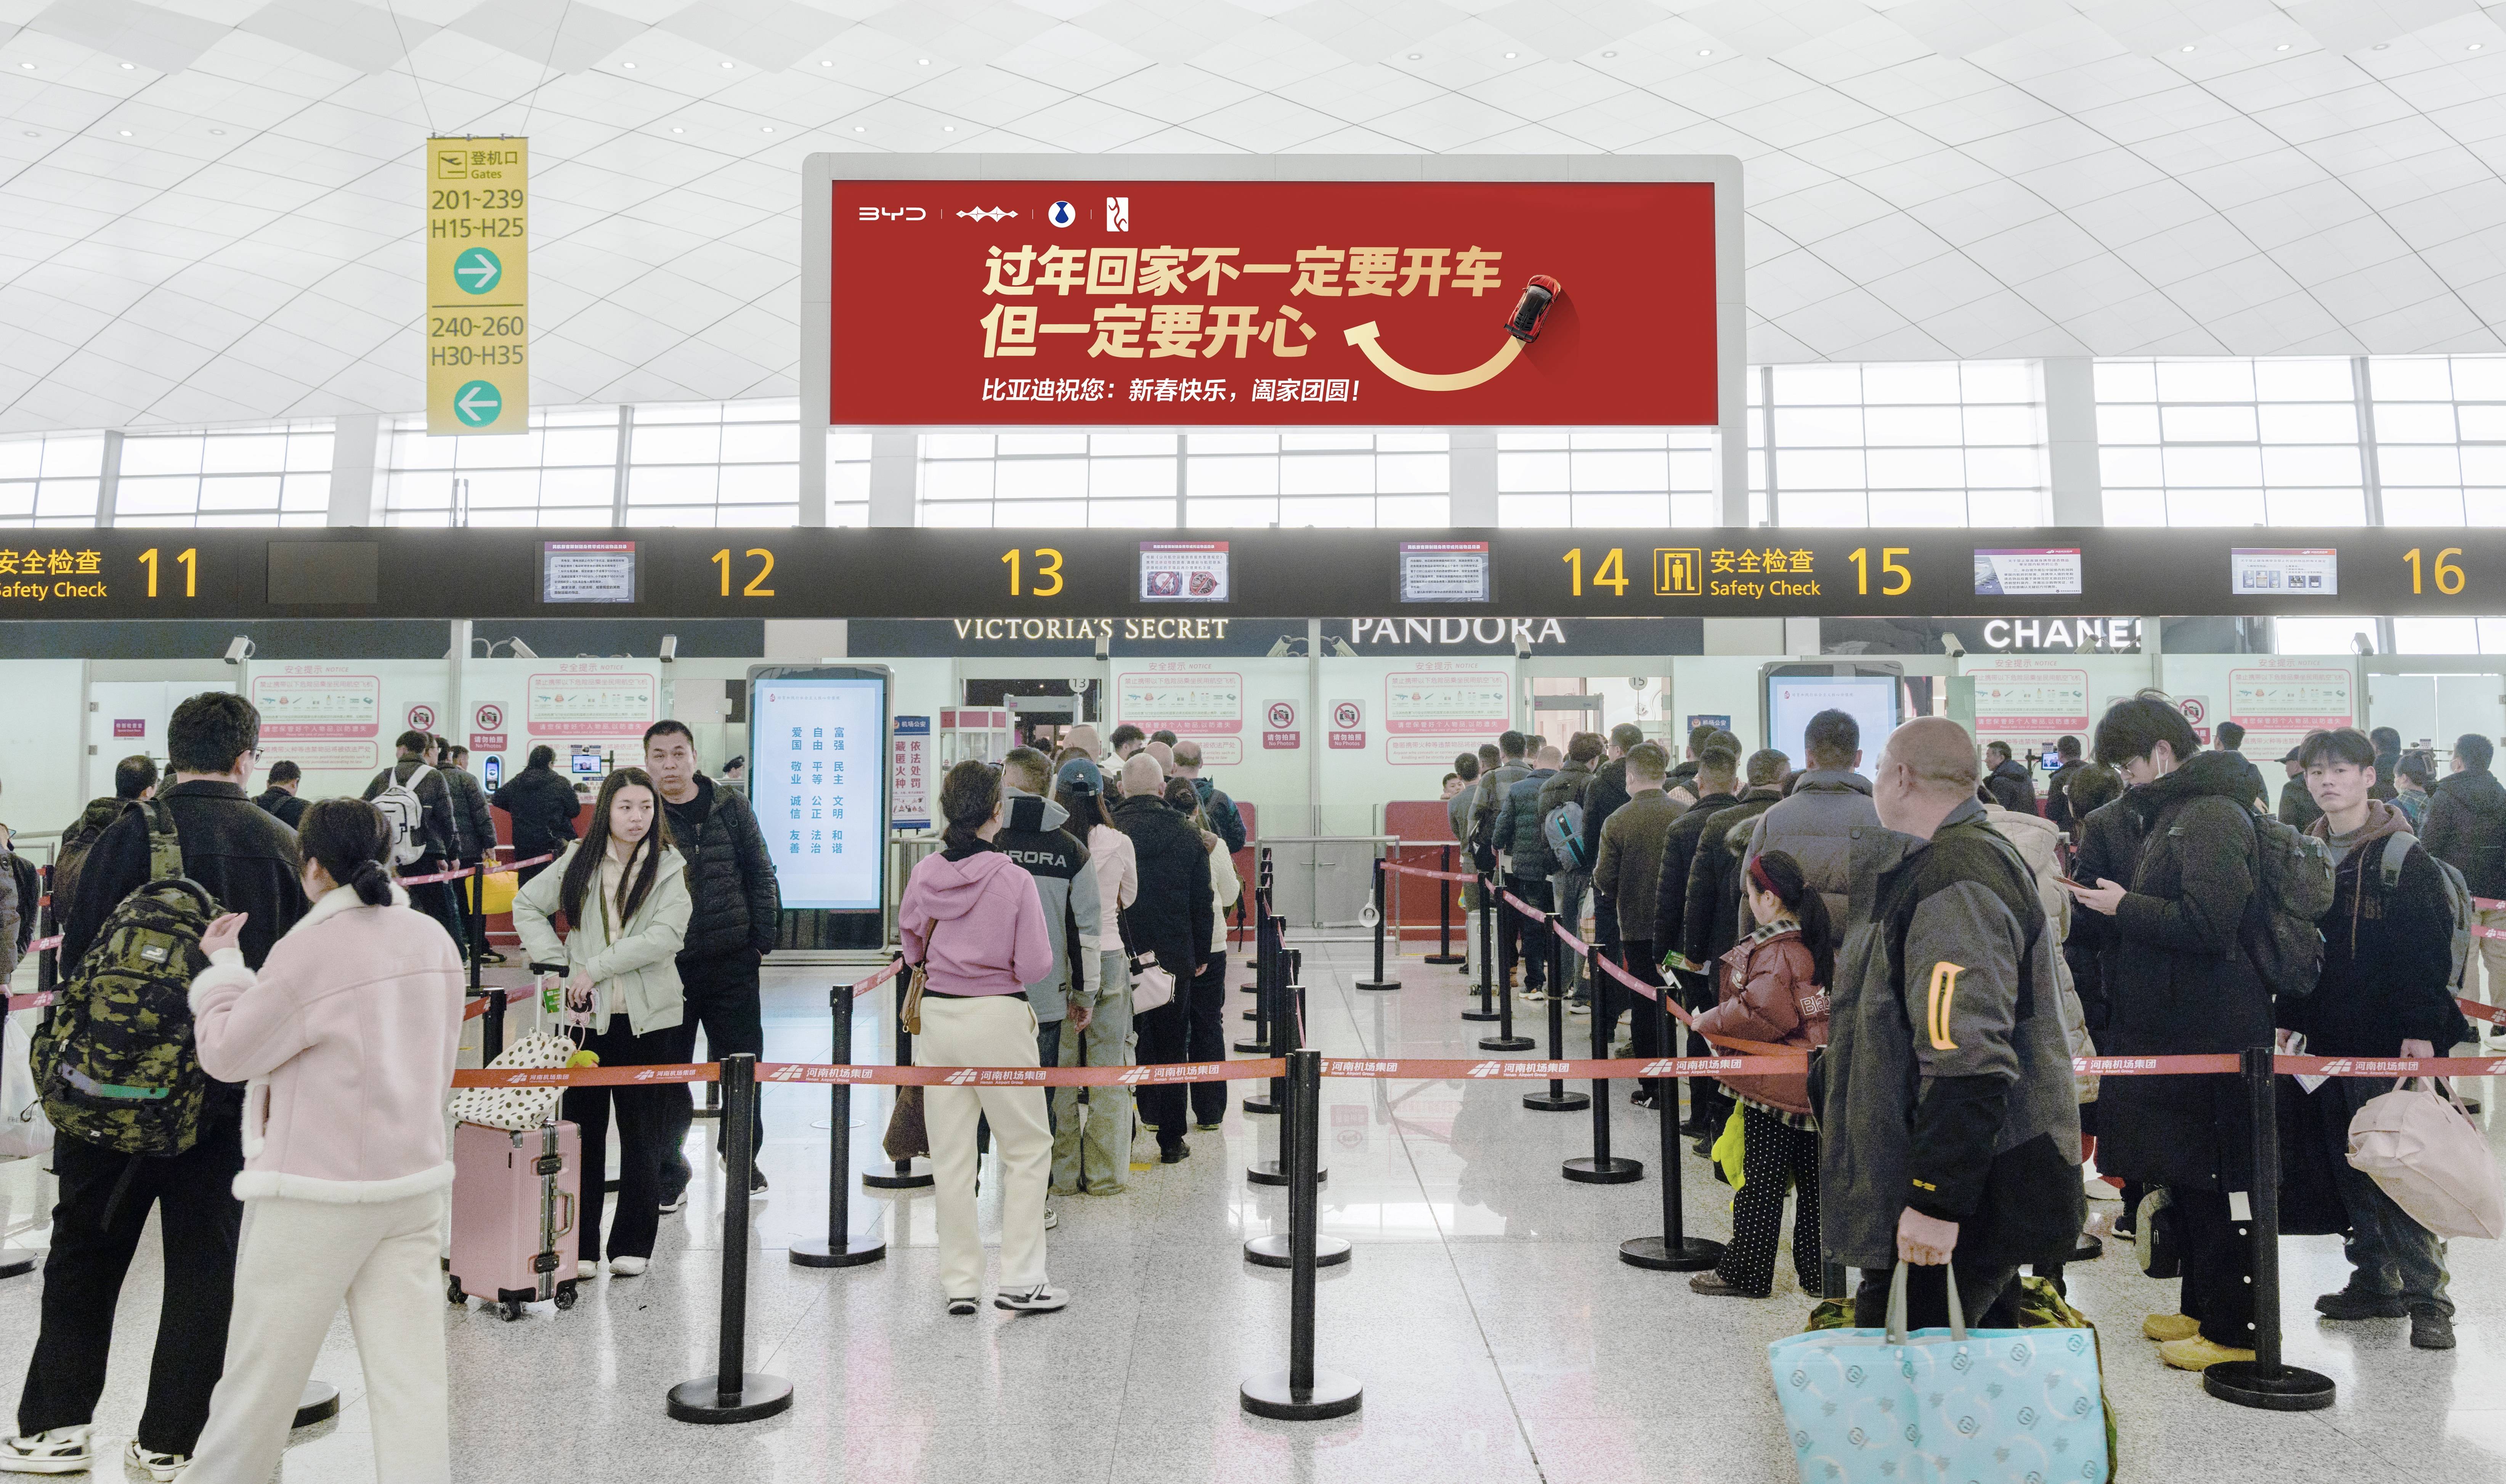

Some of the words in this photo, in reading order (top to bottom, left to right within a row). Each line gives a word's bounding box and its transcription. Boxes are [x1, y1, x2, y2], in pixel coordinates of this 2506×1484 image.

[471, 151, 518, 165] 登机口
[471, 169, 502, 179] Gates
[432, 189, 523, 209] 201~239
[859, 207, 926, 221] BYD
[432, 218, 523, 238] H15~H25
[982, 245, 1503, 297] 过年回家不一定要开车
[432, 317, 523, 337] 240~260
[980, 303, 1317, 358] 但一定要开心
[432, 345, 523, 366] H30~H35
[0, 549, 102, 575] 安全检查
[1710, 548, 1815, 574] 安全检查
[2402, 547, 2465, 595] 16
[138, 549, 196, 597] 11
[711, 548, 775, 597] 12
[1001, 548, 1064, 596] 13
[1563, 548, 1629, 596] 14
[1848, 548, 1911, 595] 15
[54, 582, 107, 597] Check
[1710, 581, 1765, 599] Safety
[1770, 581, 1821, 596] Check
[954, 619, 1113, 639] VICTORIA'S
[1125, 619, 1229, 639] SECRET
[1352, 619, 1566, 643] PANDORA
[285, 666, 322, 674] 安全提示
[560, 664, 597, 672] 安全提示
[1149, 663, 1186, 671] 安全提示
[1415, 662, 1452, 670] 安全提示
[1995, 659, 2031, 667] 安全提示
[2259, 659, 2295, 667] 安全提示
[1073, 679, 1086, 688] 13
[1632, 677, 1644, 686] 15
[792, 727, 802, 750] 爱国
[813, 727, 823, 750] 自由
[834, 727, 844, 750] 富强
[791, 762, 801, 785] 敬业
[812, 762, 823, 785] 平等
[833, 762, 844, 785] 民主
[895, 741, 906, 788] 藏匿火种
[910, 741, 921, 789] 依法处罚
[790, 796, 801, 819] 诚信
[811, 796, 821, 819] 公正
[833, 796, 843, 819] 文明
[789, 830, 800, 854] 友善
[811, 830, 821, 854] 法治
[832, 830, 842, 854] 和谐
[1003, 850, 1067, 868] RORA
[806, 1068, 873, 1078] 河南机场集团
[1154, 1065, 1219, 1078] 河南机场集团
[1332, 1062, 1398, 1072] 河南机场集团
[1504, 1063, 1569, 1073] 河南机场集团
[1676, 1059, 1742, 1070] 河南机场集团
[2090, 1059, 2156, 1069] 河南机场集团
[2355, 1061, 2419, 1070] 河南机场集团
[980, 1071, 1046, 1080] 河南机场集团
